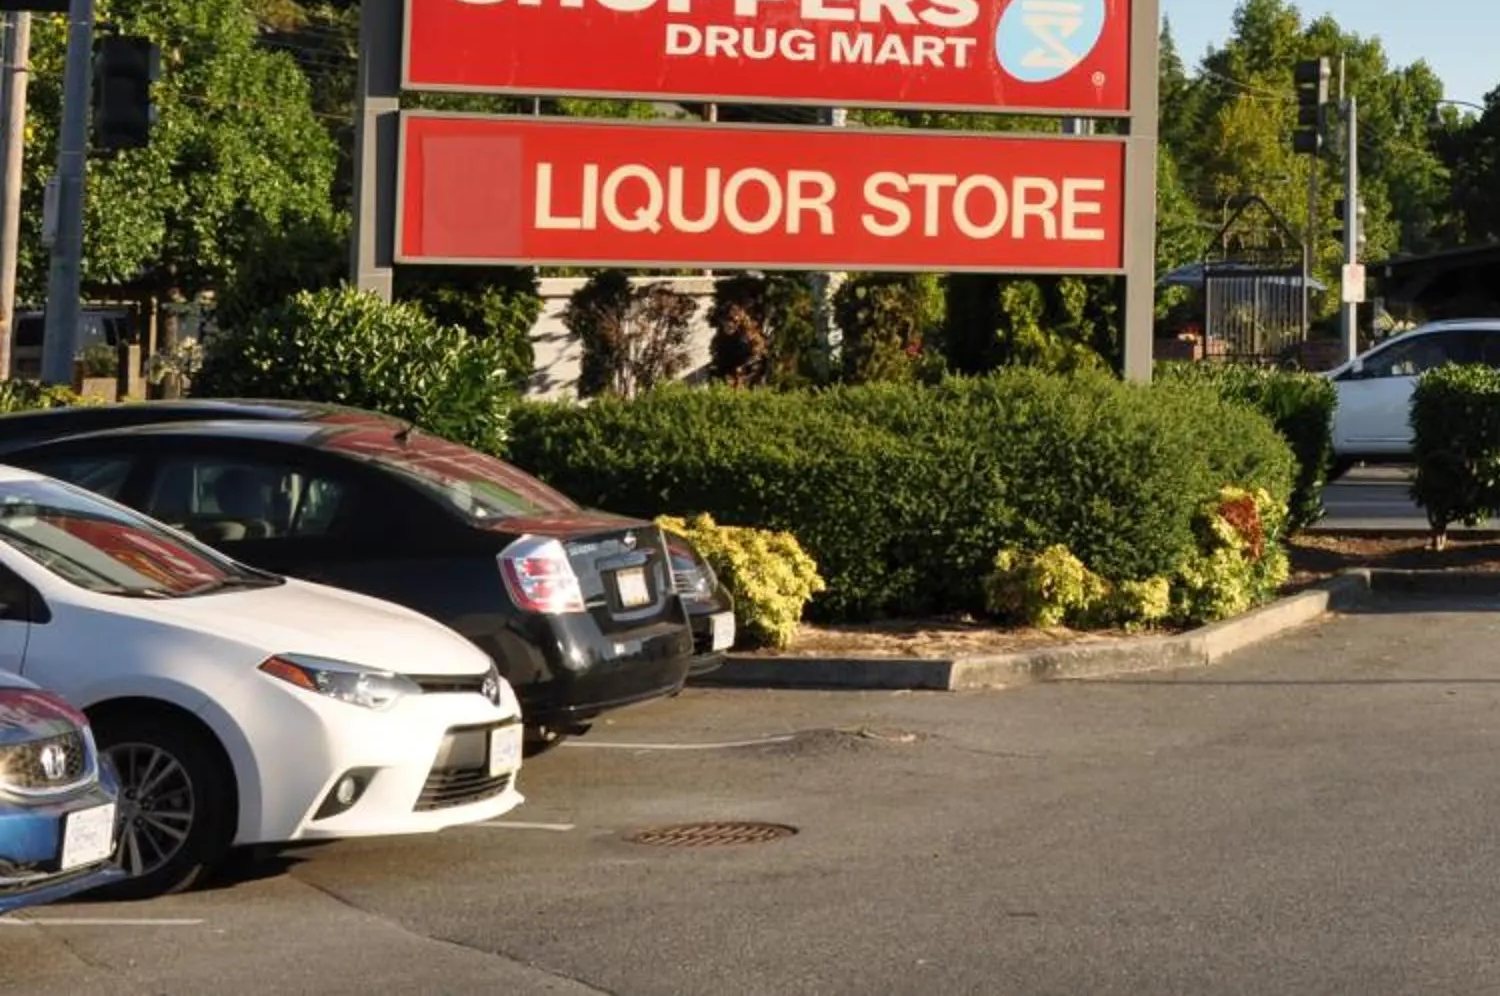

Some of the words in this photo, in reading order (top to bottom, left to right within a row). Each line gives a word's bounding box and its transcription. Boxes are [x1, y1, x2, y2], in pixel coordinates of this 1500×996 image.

[665, 24, 816, 61] DRUG
[830, 31, 977, 68] MART
[534, 162, 834, 234] LIQUOR
[861, 172, 1105, 240] STORE
